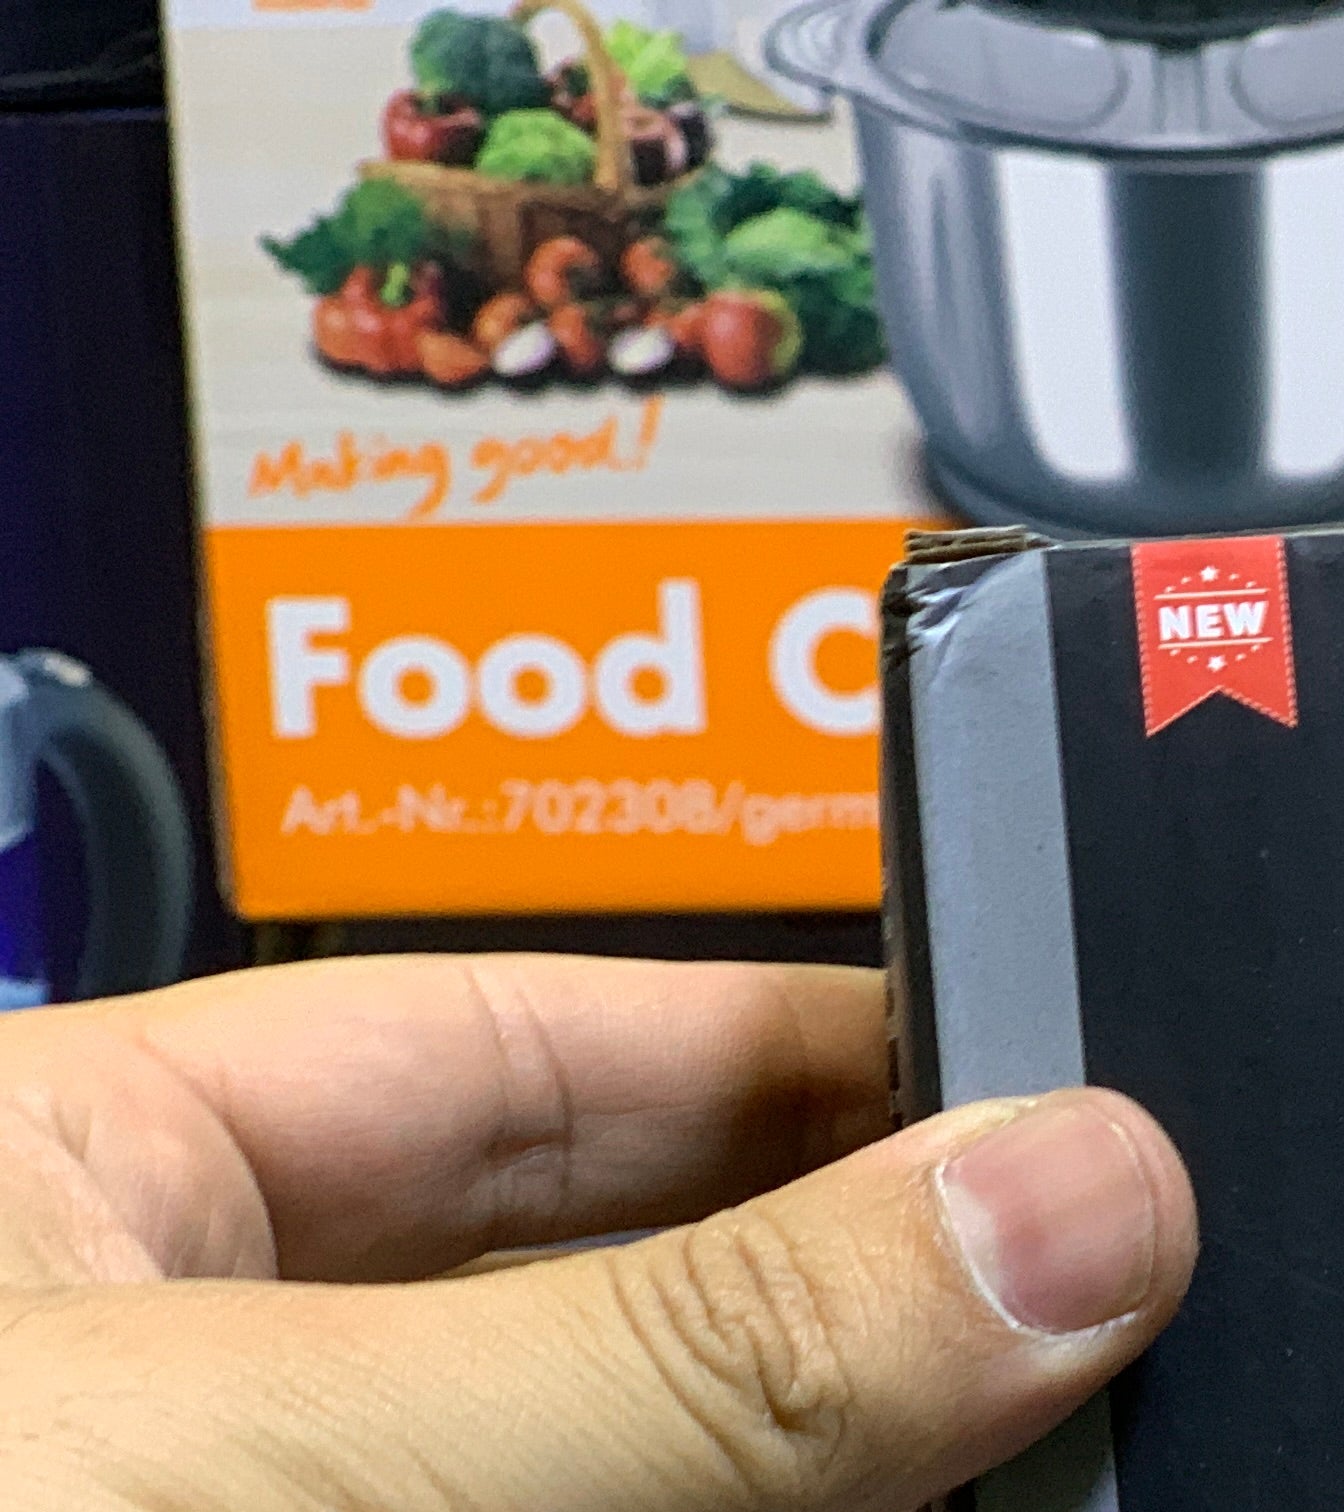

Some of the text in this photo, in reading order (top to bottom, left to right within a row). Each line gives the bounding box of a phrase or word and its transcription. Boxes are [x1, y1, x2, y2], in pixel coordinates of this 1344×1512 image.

[470, 393, 664, 503] good!
[265, 577, 879, 740] Food C
[1158, 600, 1270, 641] NEW
